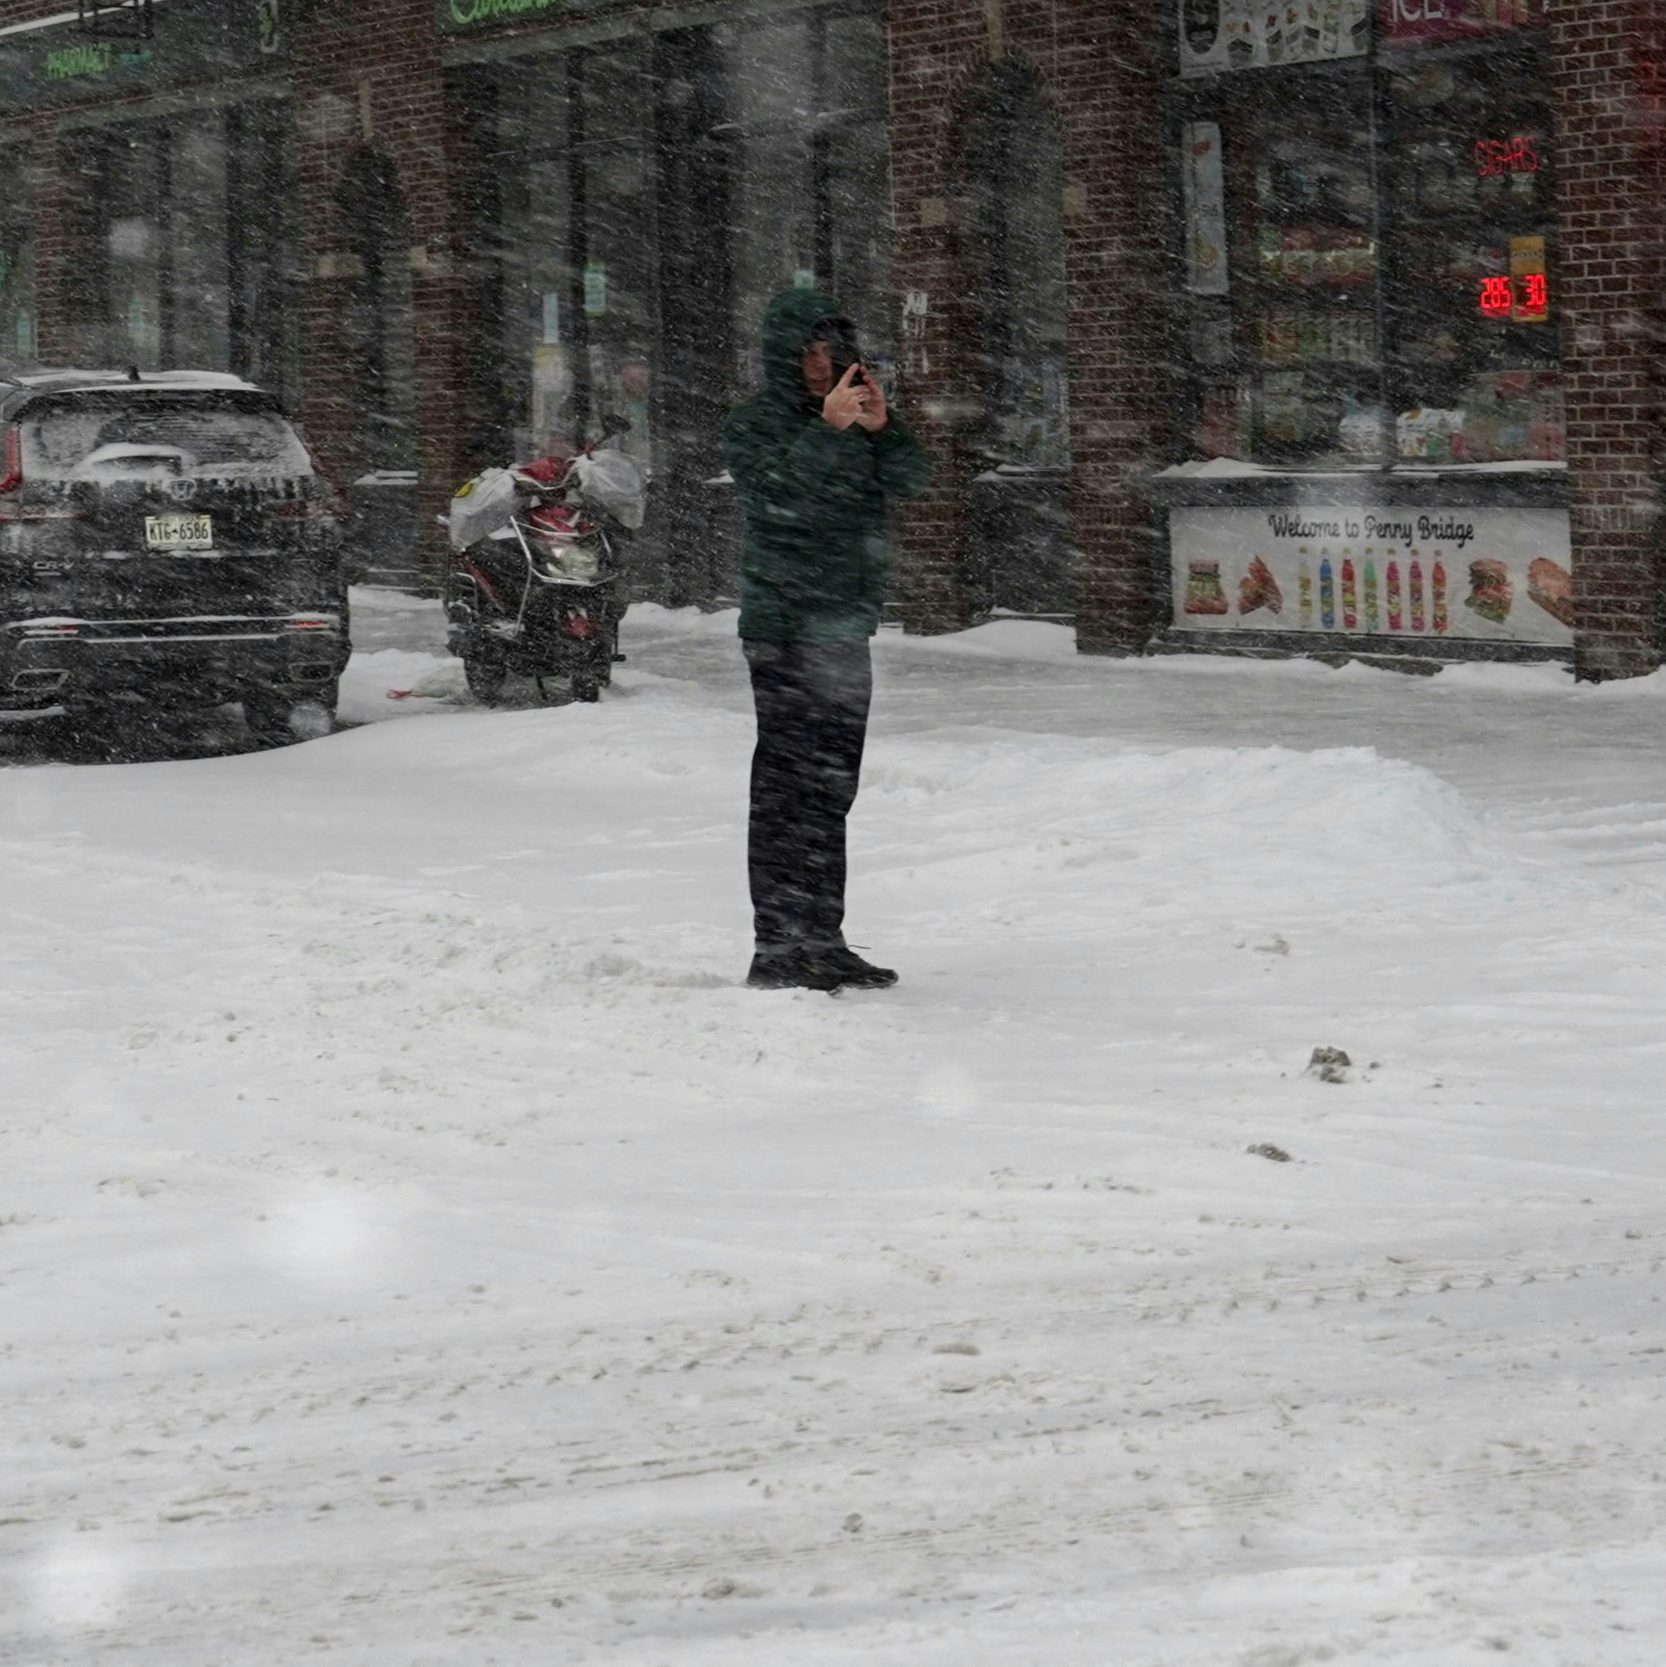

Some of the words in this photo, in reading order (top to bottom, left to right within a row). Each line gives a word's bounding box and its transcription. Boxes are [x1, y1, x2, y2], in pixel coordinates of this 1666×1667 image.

[1473, 136, 1539, 177] CIGARS
[1479, 276, 1512, 309] 285
[1524, 274, 1547, 306] 30
[1268, 513, 1341, 539] Welcome
[1346, 516, 1361, 539] to
[1364, 514, 1413, 549] Penny
[1417, 514, 1475, 550] Bridge
